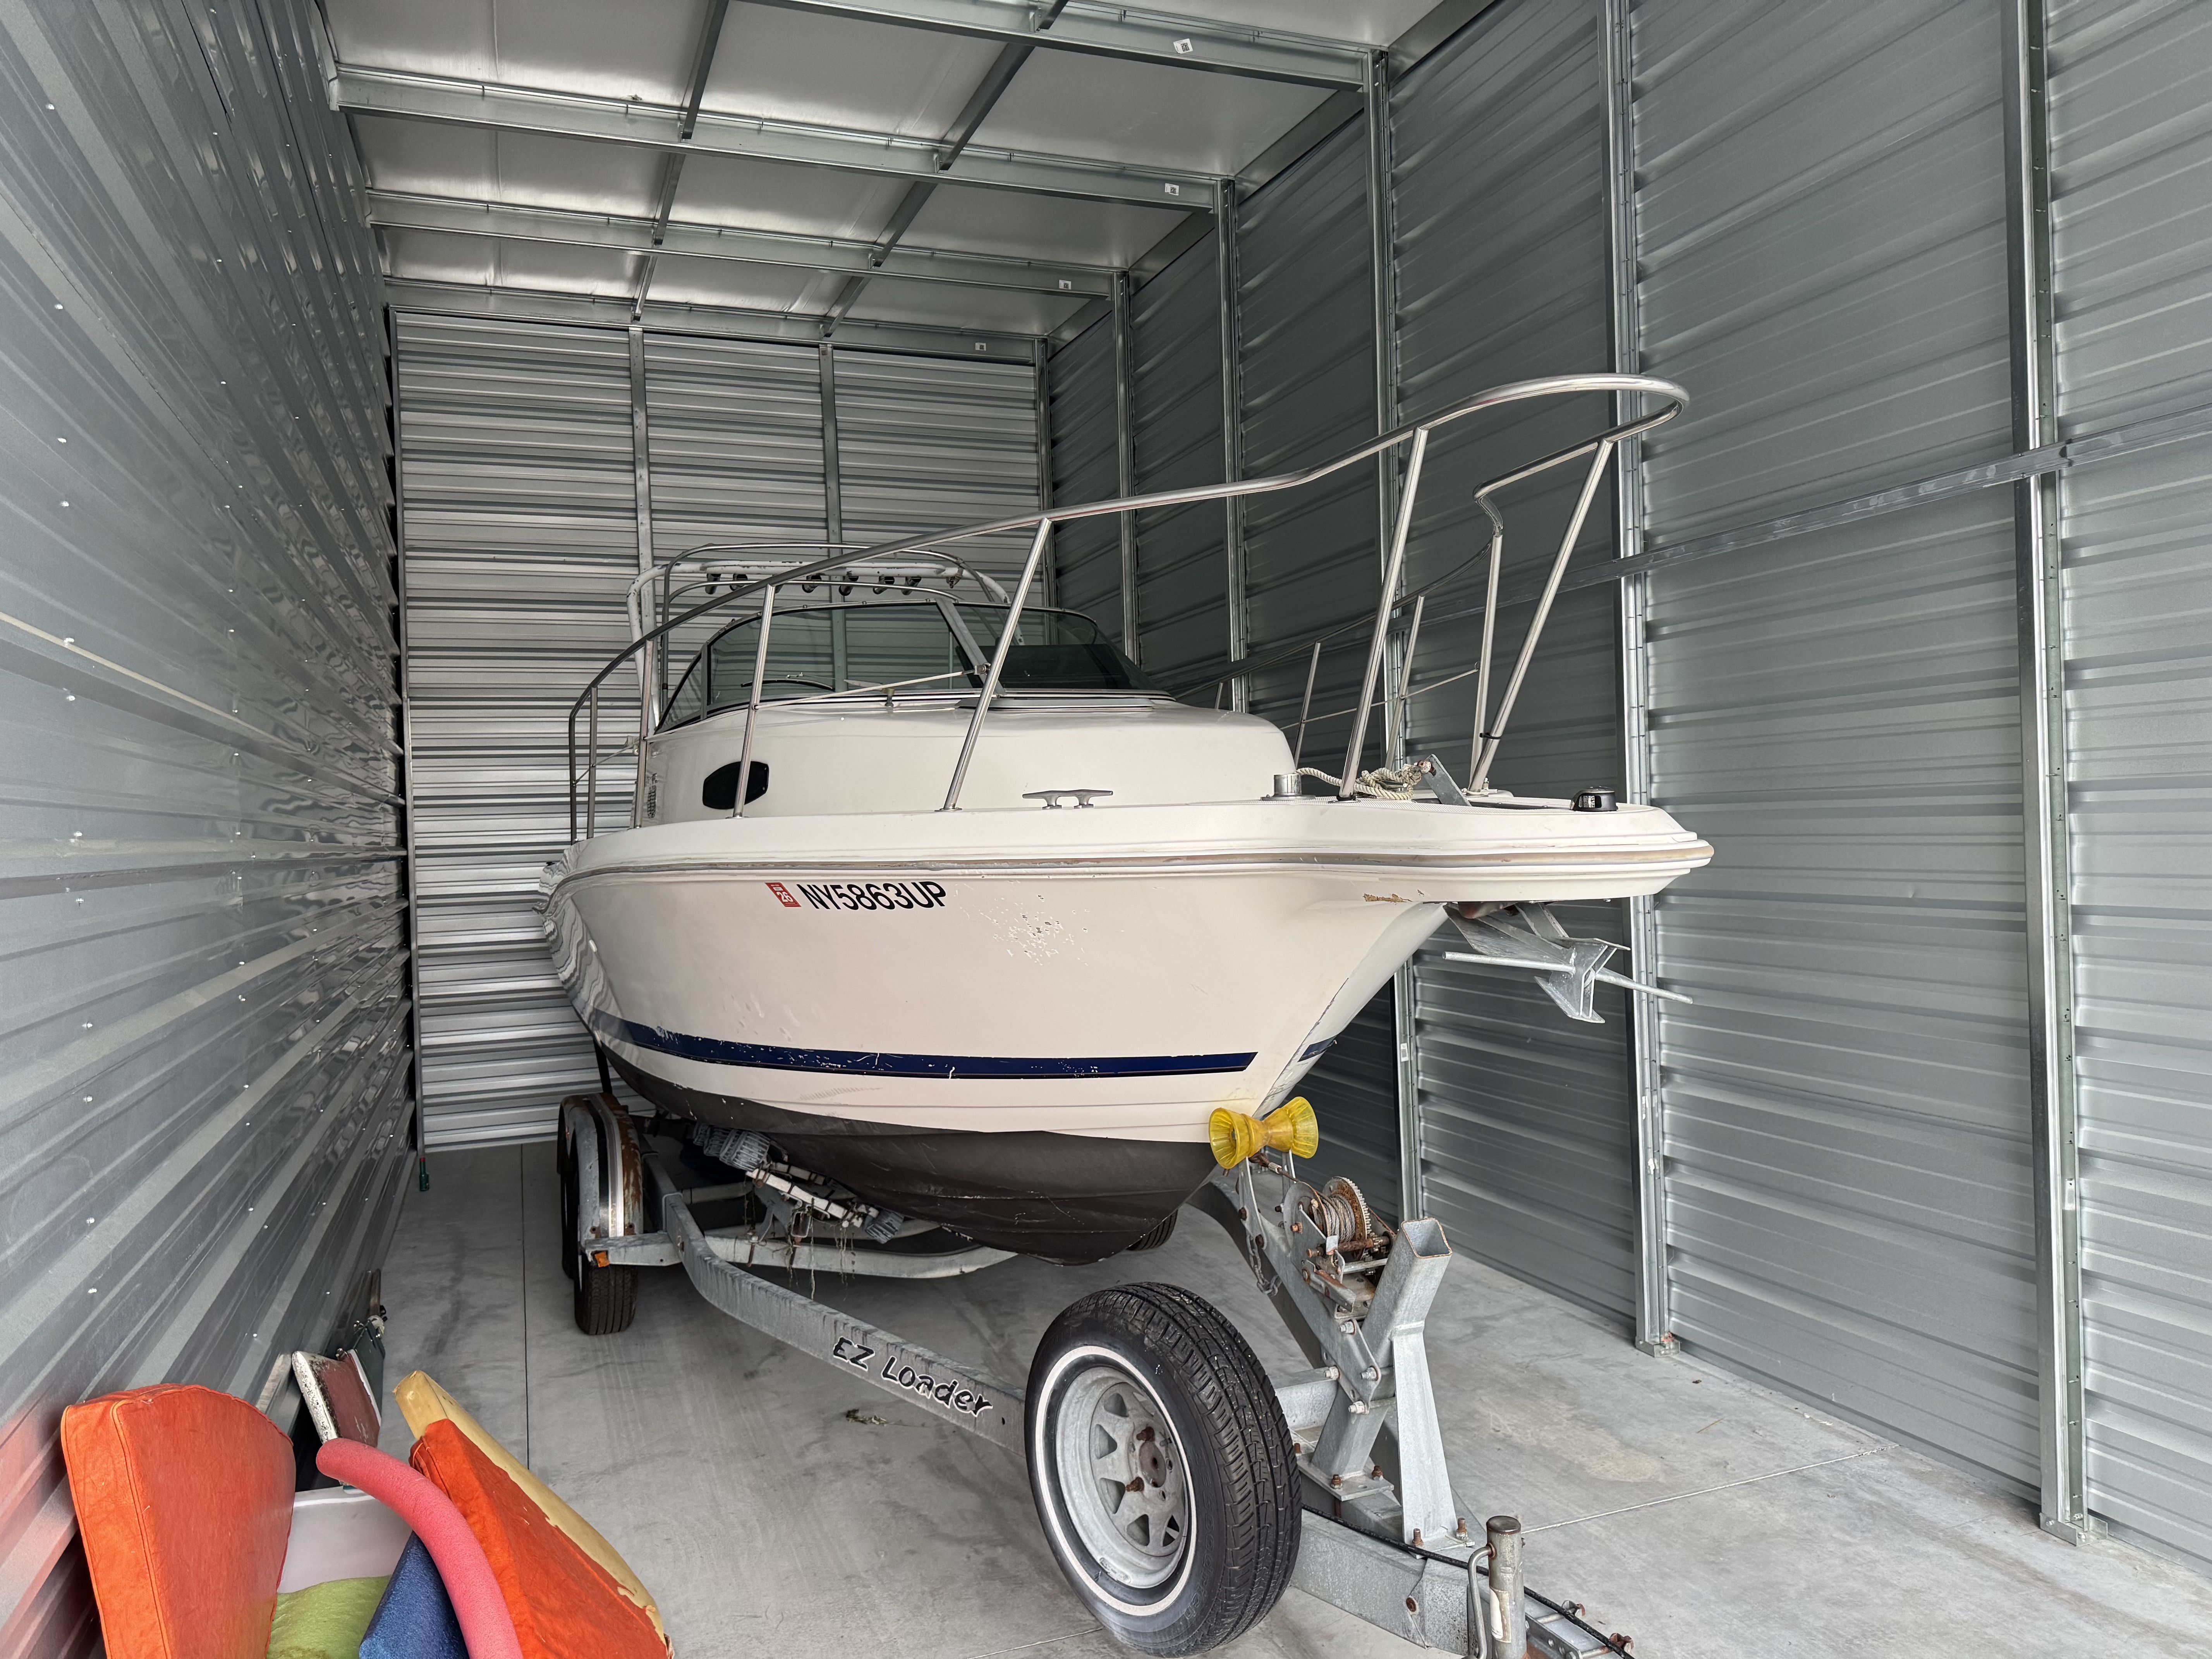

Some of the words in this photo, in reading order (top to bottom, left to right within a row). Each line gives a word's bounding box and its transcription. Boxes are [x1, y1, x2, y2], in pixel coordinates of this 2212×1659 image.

[776, 891, 793, 902] 26
[796, 881, 946, 910] NY5863UP
[833, 1336, 875, 1371] EZ
[881, 1356, 993, 1417] Loader
